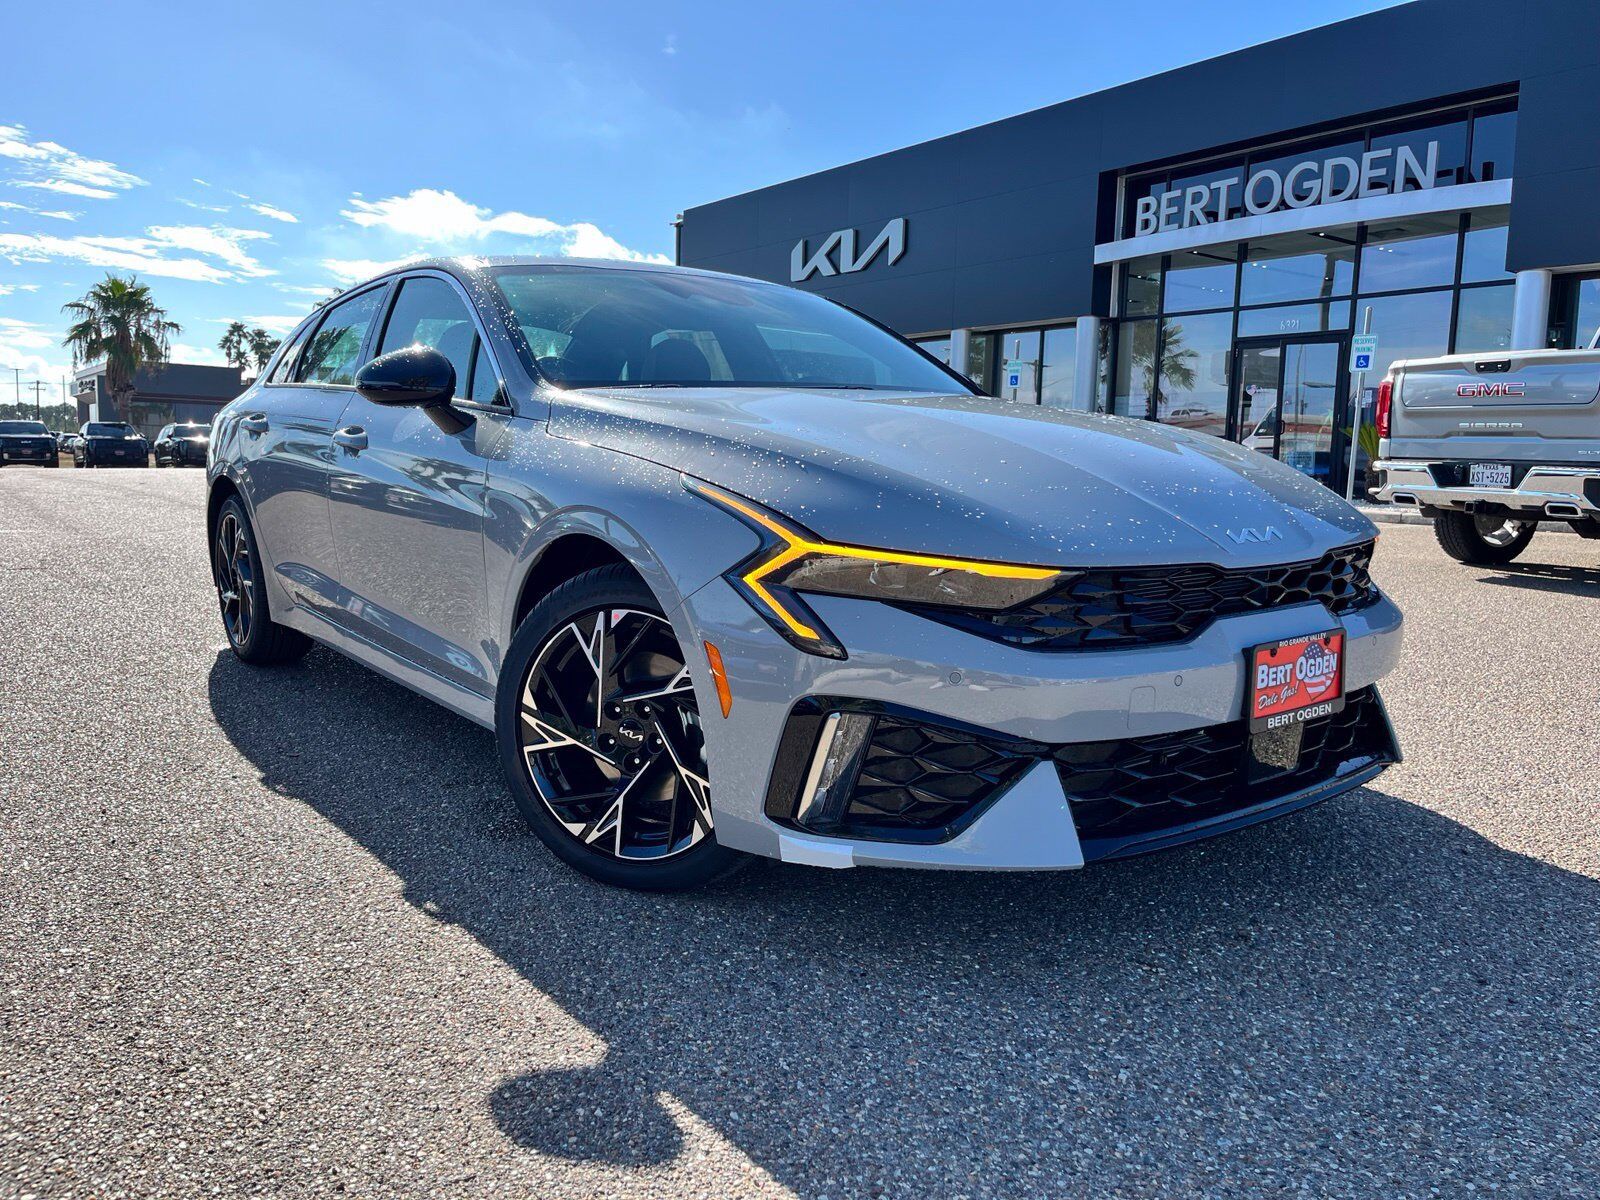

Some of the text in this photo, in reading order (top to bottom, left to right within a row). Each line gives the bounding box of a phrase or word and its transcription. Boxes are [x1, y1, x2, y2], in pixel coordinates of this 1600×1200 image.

[1135, 141, 1440, 237] BERT OGDEN
[791, 217, 907, 282] KIA
[1456, 382, 1527, 398] GMC
[1226, 526, 1283, 544] KIA
[1289, 636, 1309, 646] GRANDE
[1309, 632, 1327, 641] VALLEY
[1257, 652, 1338, 690] BERT OGDEN
[1258, 681, 1299, 710] Dale Gas!
[1267, 703, 1332, 729] BERT OGDEN
[618, 726, 643, 742] KIA
